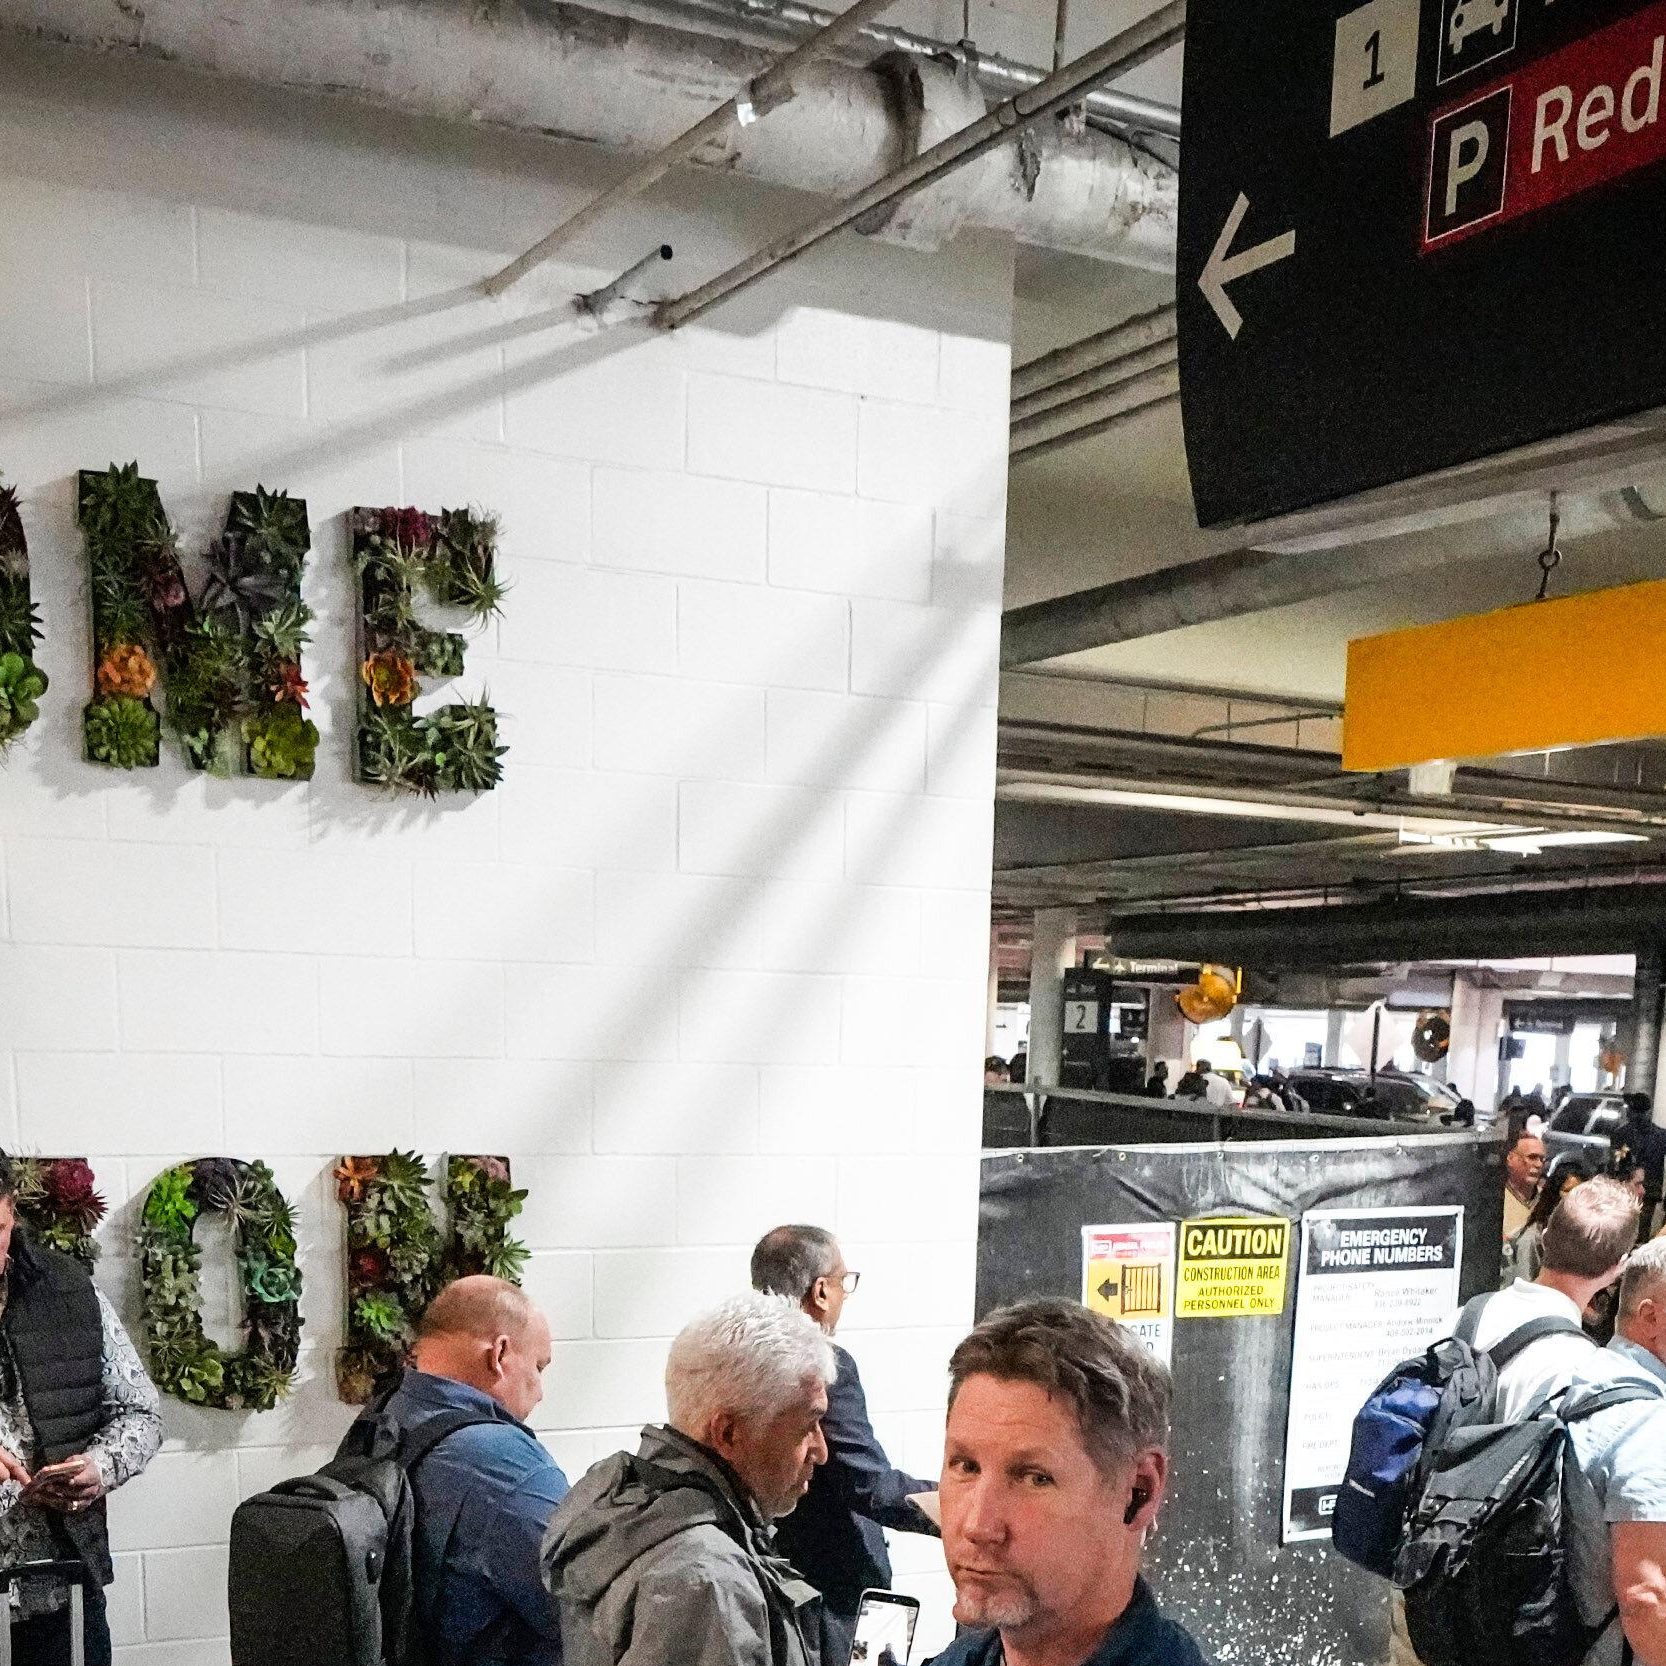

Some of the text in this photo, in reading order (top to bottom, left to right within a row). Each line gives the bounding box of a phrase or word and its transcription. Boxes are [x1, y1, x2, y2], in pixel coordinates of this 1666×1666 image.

[1529, 36, 1665, 174] Red
[1075, 1003, 1086, 1030] 2
[1187, 1228, 1283, 1256] CAUTION
[1340, 1228, 1428, 1248] EMERGENCY
[1321, 1245, 1443, 1267] PHONE NUMBERS
[1183, 1265, 1280, 1282] CONSTRUCTION AREA
[1197, 1285, 1264, 1297] AUTHORIZED
[1183, 1298, 1275, 1311] PERSONNEL ONLY
